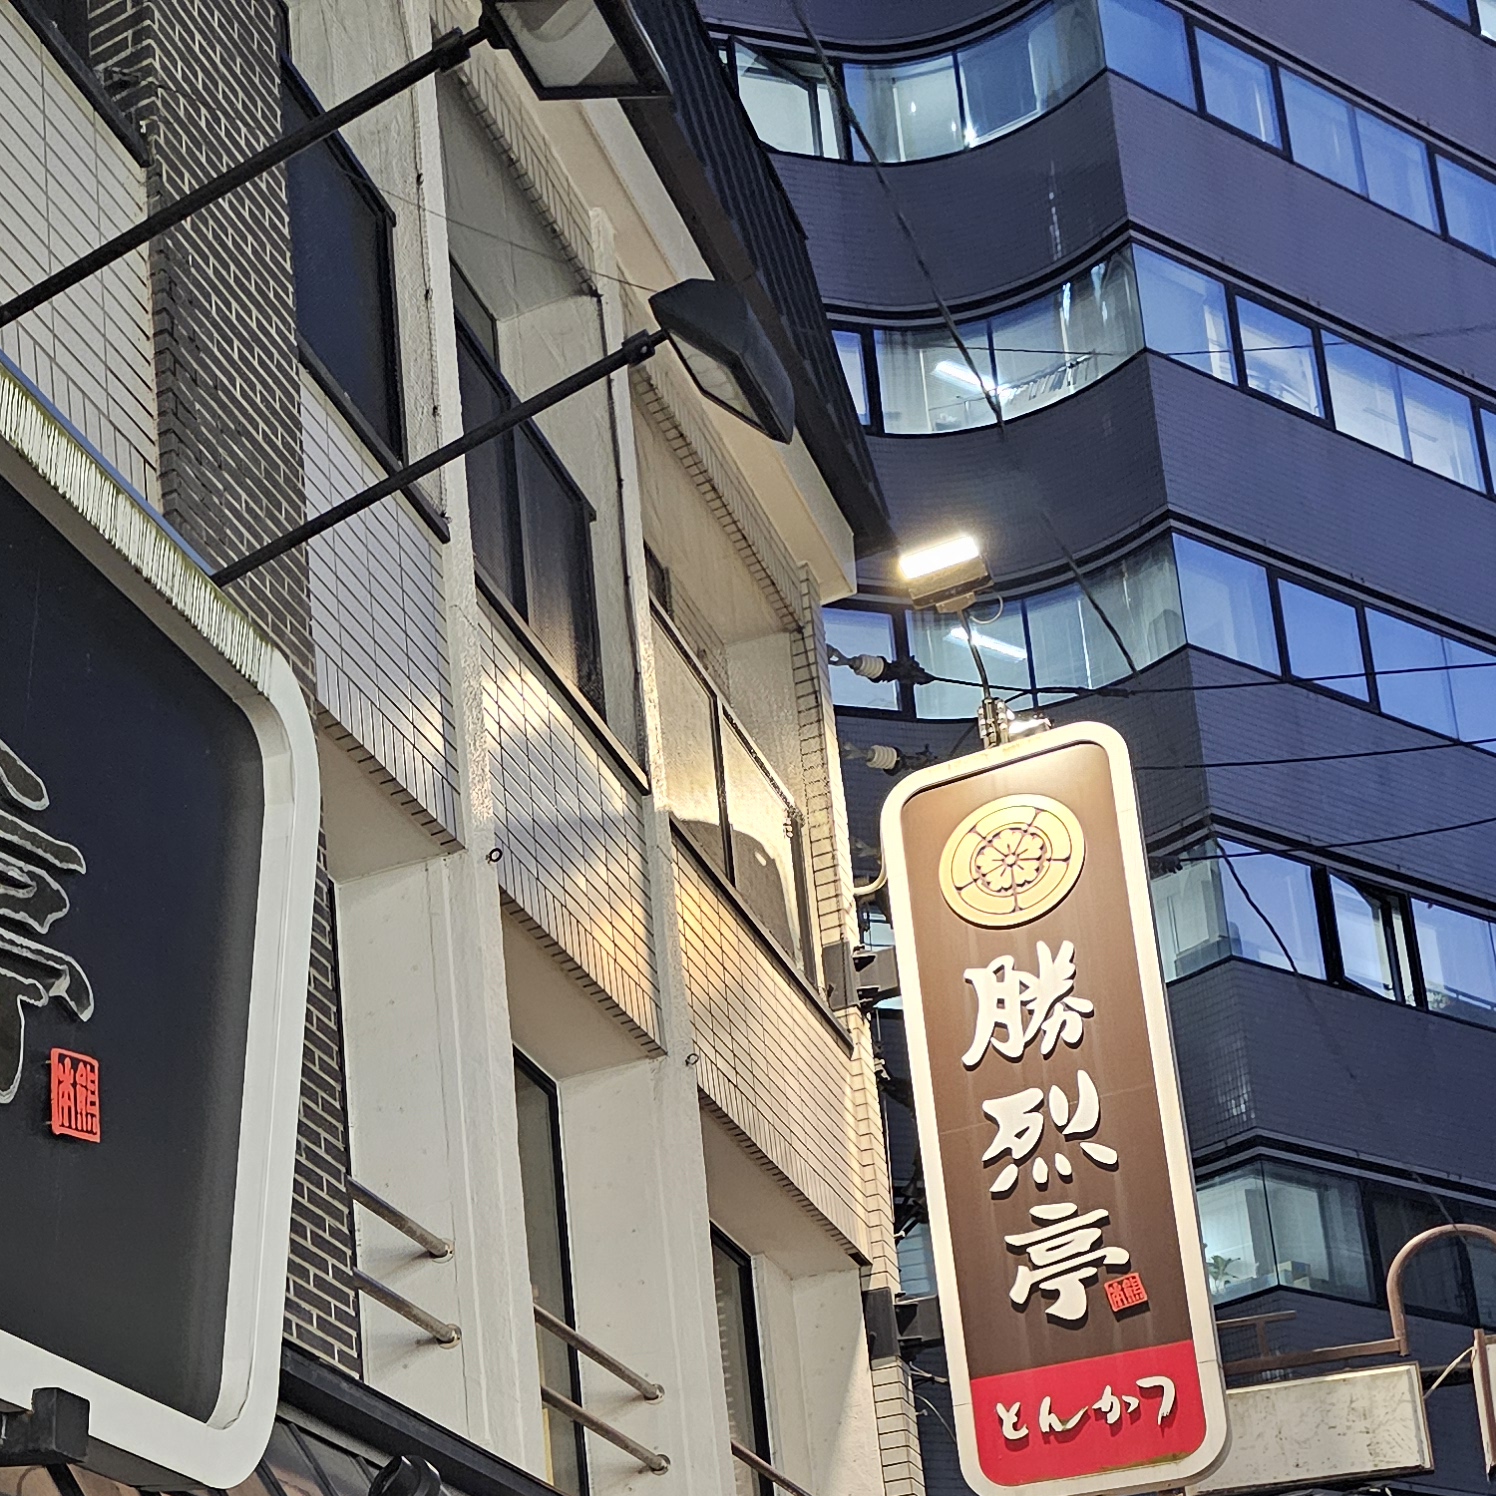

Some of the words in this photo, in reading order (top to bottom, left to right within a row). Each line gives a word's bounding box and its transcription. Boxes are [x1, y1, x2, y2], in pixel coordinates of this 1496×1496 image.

[962, 940, 1131, 1323] 勝烈亭
[996, 1374, 1177, 1442] とんかつ
